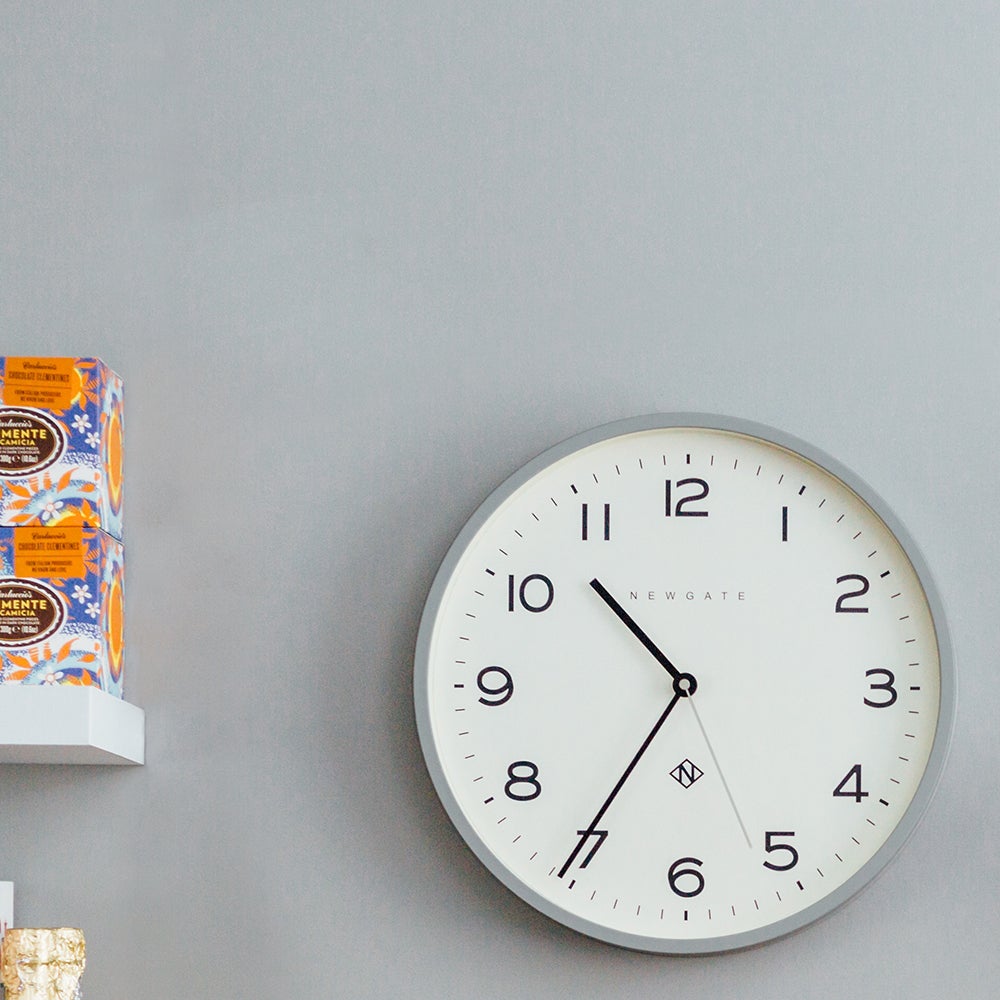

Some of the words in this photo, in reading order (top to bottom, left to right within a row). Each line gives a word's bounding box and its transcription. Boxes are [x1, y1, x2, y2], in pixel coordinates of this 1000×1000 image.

[2, 429, 47, 439] MENTE
[665, 478, 709, 517] 12
[581, 503, 610, 541] 11
[782, 506, 788, 542] 1
[2, 600, 47, 610] MENTE
[508, 573, 554, 612] 10
[835, 574, 869, 613] 2
[629, 591, 745, 600] NEWGATE
[476, 666, 514, 706] 9
[864, 668, 898, 708] 3
[504, 761, 542, 801] 8
[833, 764, 869, 803] 4
[577, 830, 609, 869] 7
[763, 831, 798, 871] 5
[668, 858, 705, 898] 6
